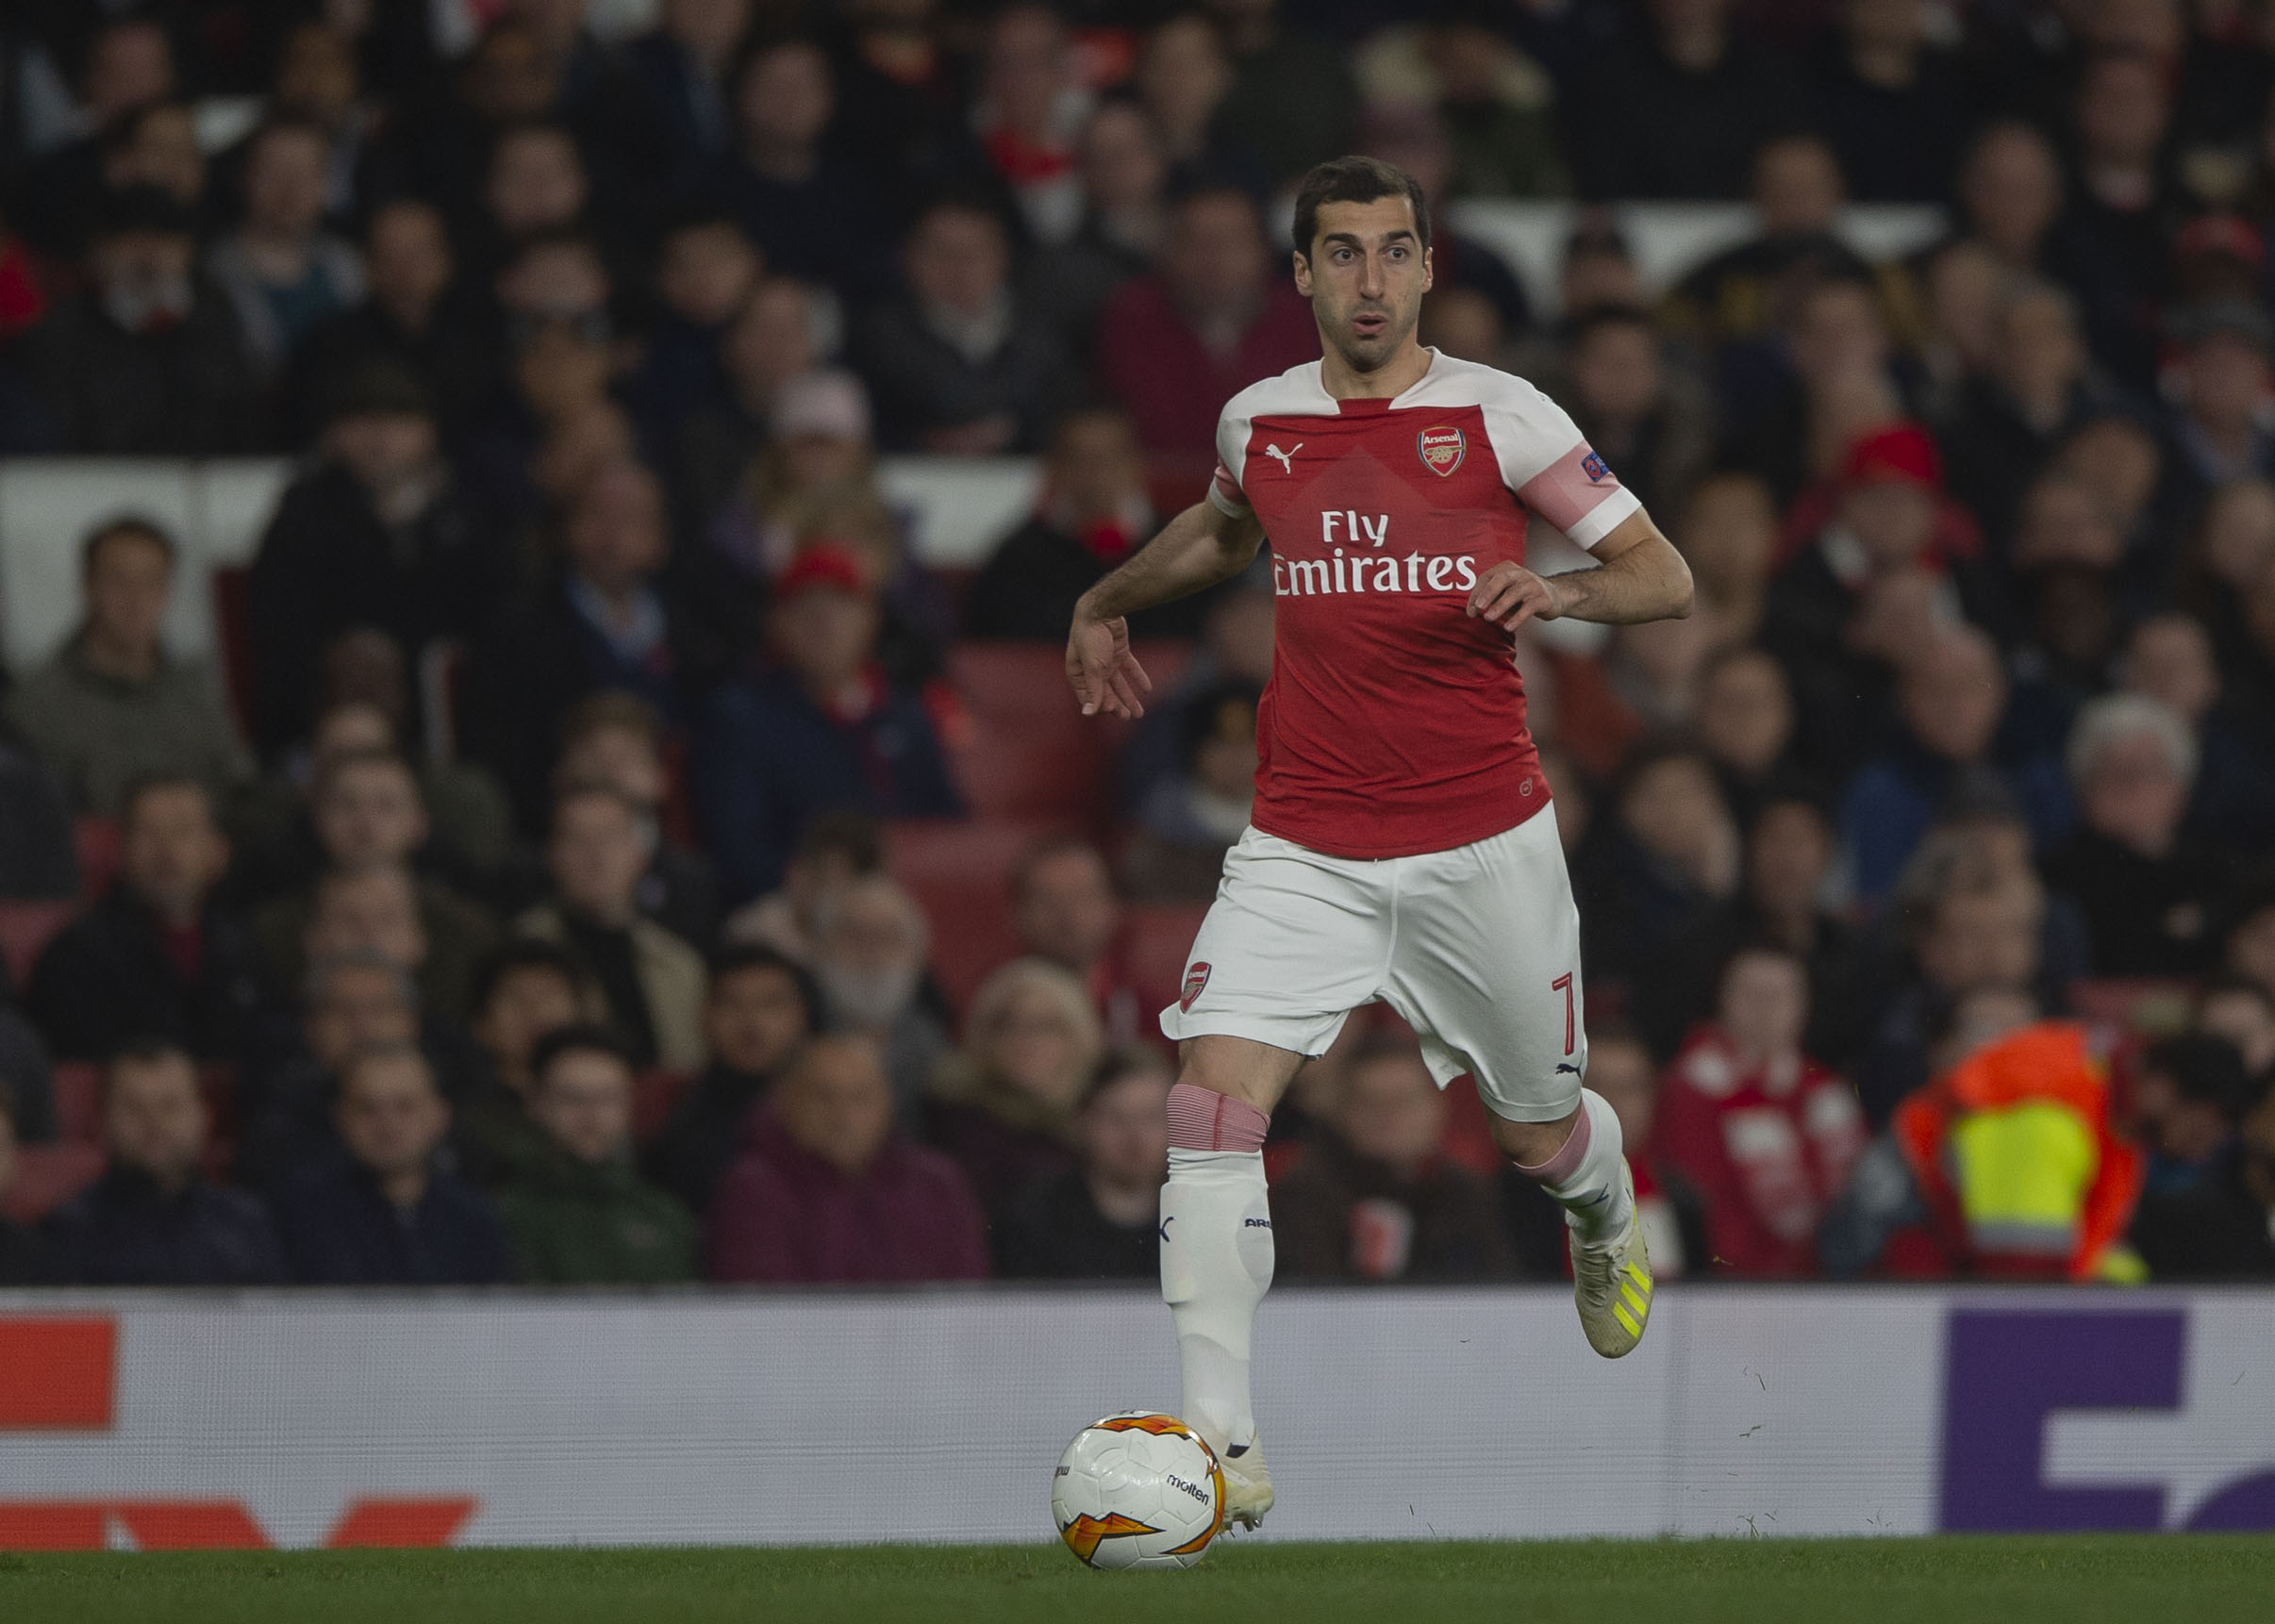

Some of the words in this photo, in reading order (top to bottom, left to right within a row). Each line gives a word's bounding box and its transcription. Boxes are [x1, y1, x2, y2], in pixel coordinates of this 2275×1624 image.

[1424, 434, 1459, 444] Arsenal
[1321, 510, 1389, 547] Fly
[1274, 548, 1477, 596] Emirates
[1552, 971, 1574, 1056] 7
[1167, 1474, 1209, 1506] molten
